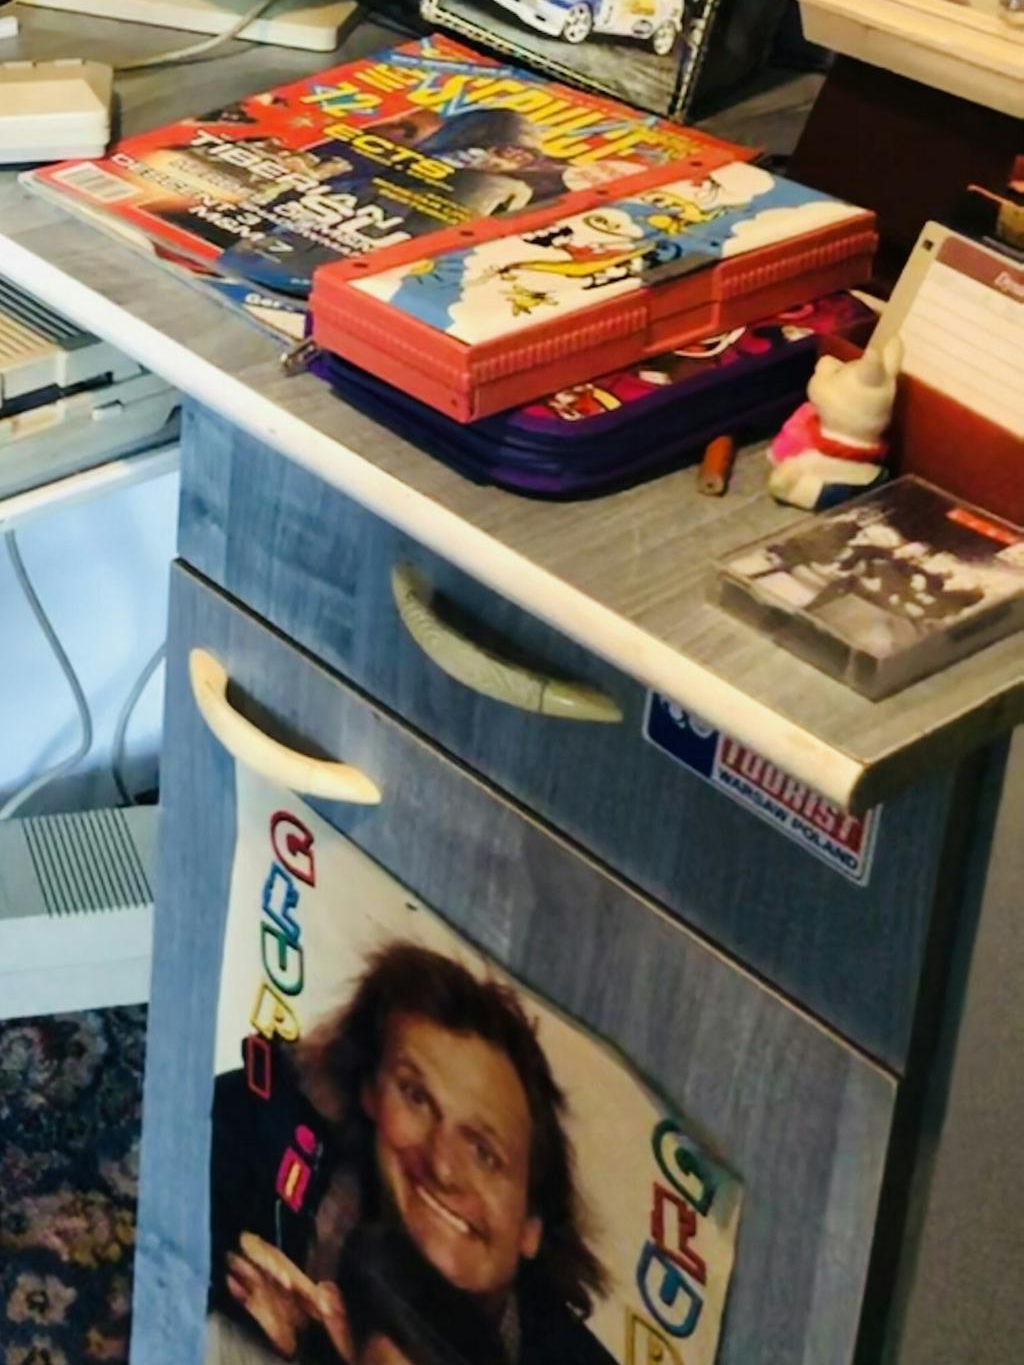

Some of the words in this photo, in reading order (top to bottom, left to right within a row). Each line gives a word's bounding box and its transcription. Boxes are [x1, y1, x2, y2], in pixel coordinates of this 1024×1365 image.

[190, 129, 405, 229] TIBERIAN
[323, 123, 456, 180] ECTS
[788, 817, 859, 871] POLAND
